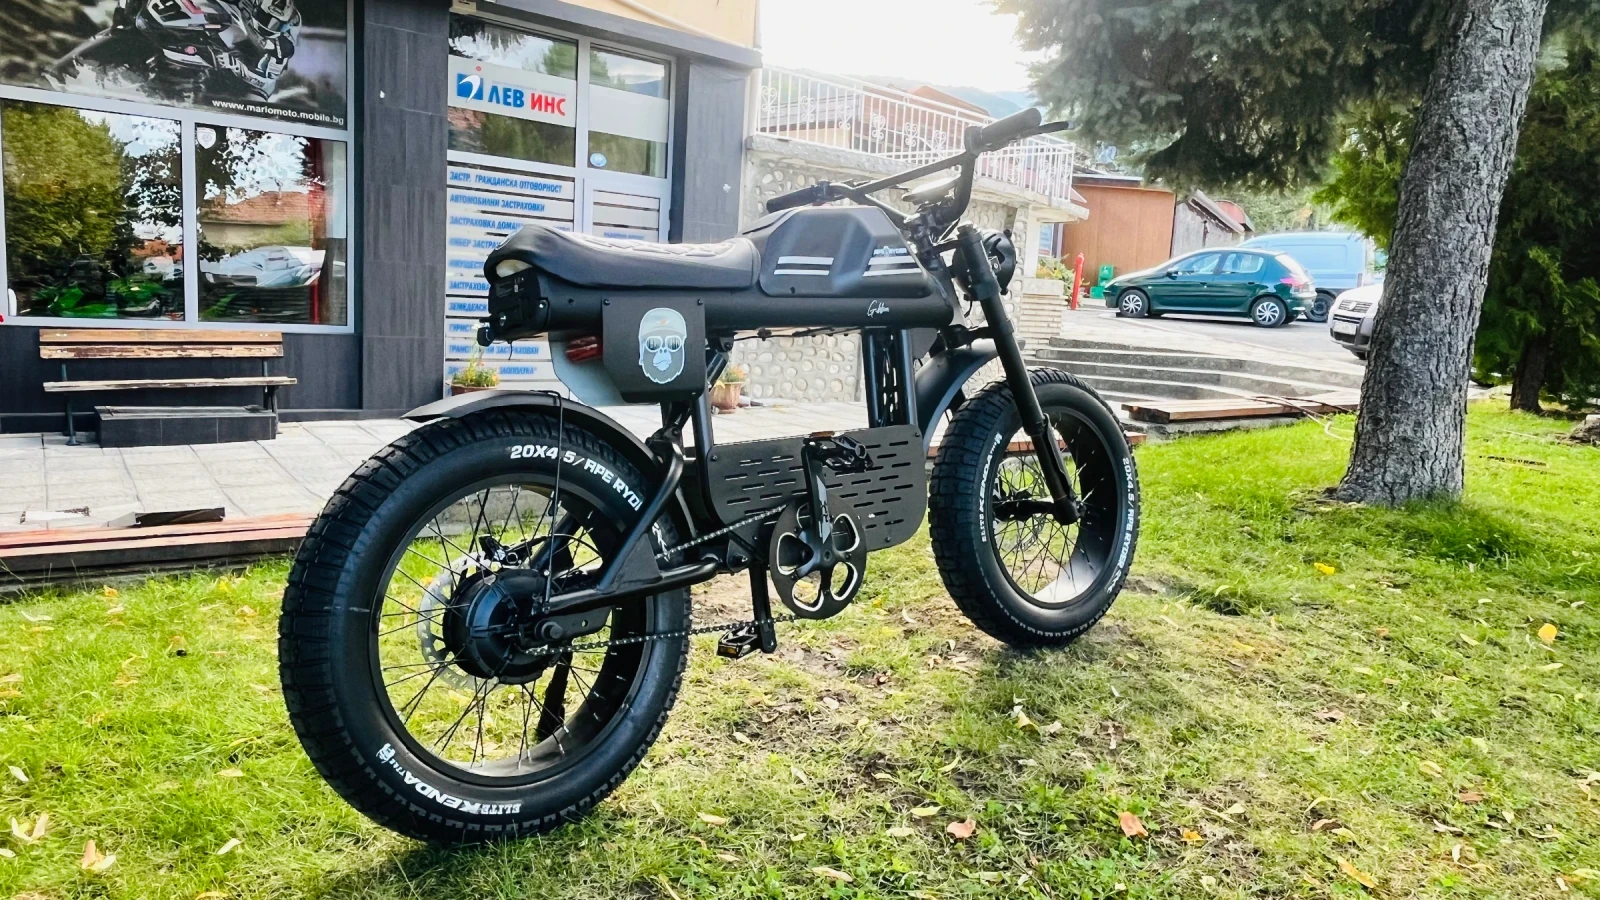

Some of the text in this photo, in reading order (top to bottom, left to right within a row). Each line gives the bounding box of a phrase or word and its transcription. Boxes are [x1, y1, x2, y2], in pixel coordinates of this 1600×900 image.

[488, 85, 525, 108] ЛЕВ
[530, 92, 567, 117] ИНС
[475, 174, 518, 188] ГРАЖДАНСКА
[519, 180, 562, 193] ОТГОВОРНОСТ
[450, 194, 545, 212] АВТОМОБИЛНИ ЗАСТРАХОВКИ
[450, 216, 496, 229] ЗАСТРАХОВКА
[510, 444, 584, 467] 20X45/
[403, 770, 482, 815] KENDA
[481, 803, 522, 815] ELITE
